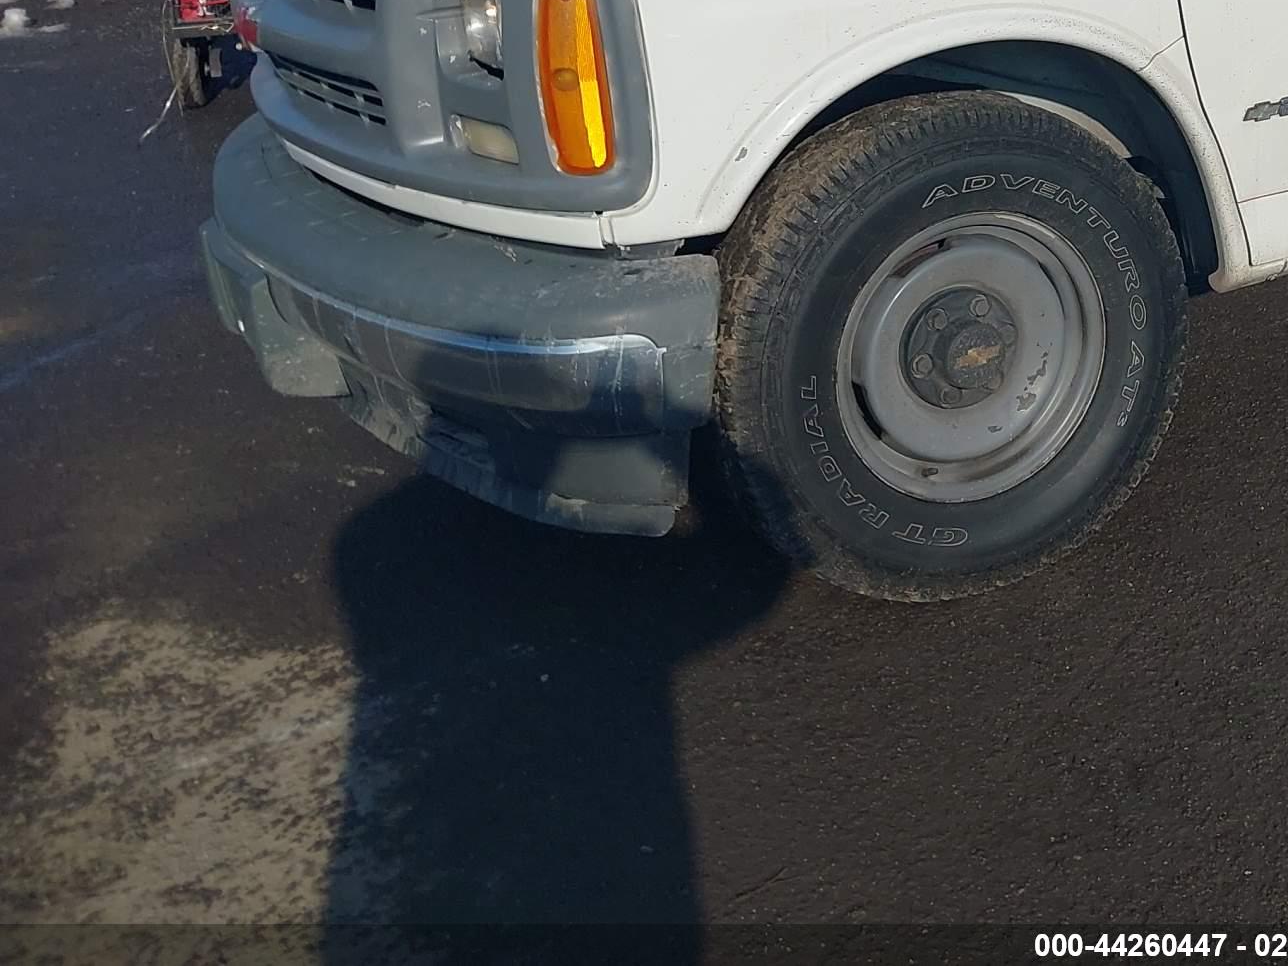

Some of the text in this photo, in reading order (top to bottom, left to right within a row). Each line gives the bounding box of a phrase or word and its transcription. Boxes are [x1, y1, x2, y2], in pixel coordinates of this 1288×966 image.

[921, 173, 1147, 331] ADVENTURO
[801, 374, 969, 547] GT RADIAL
